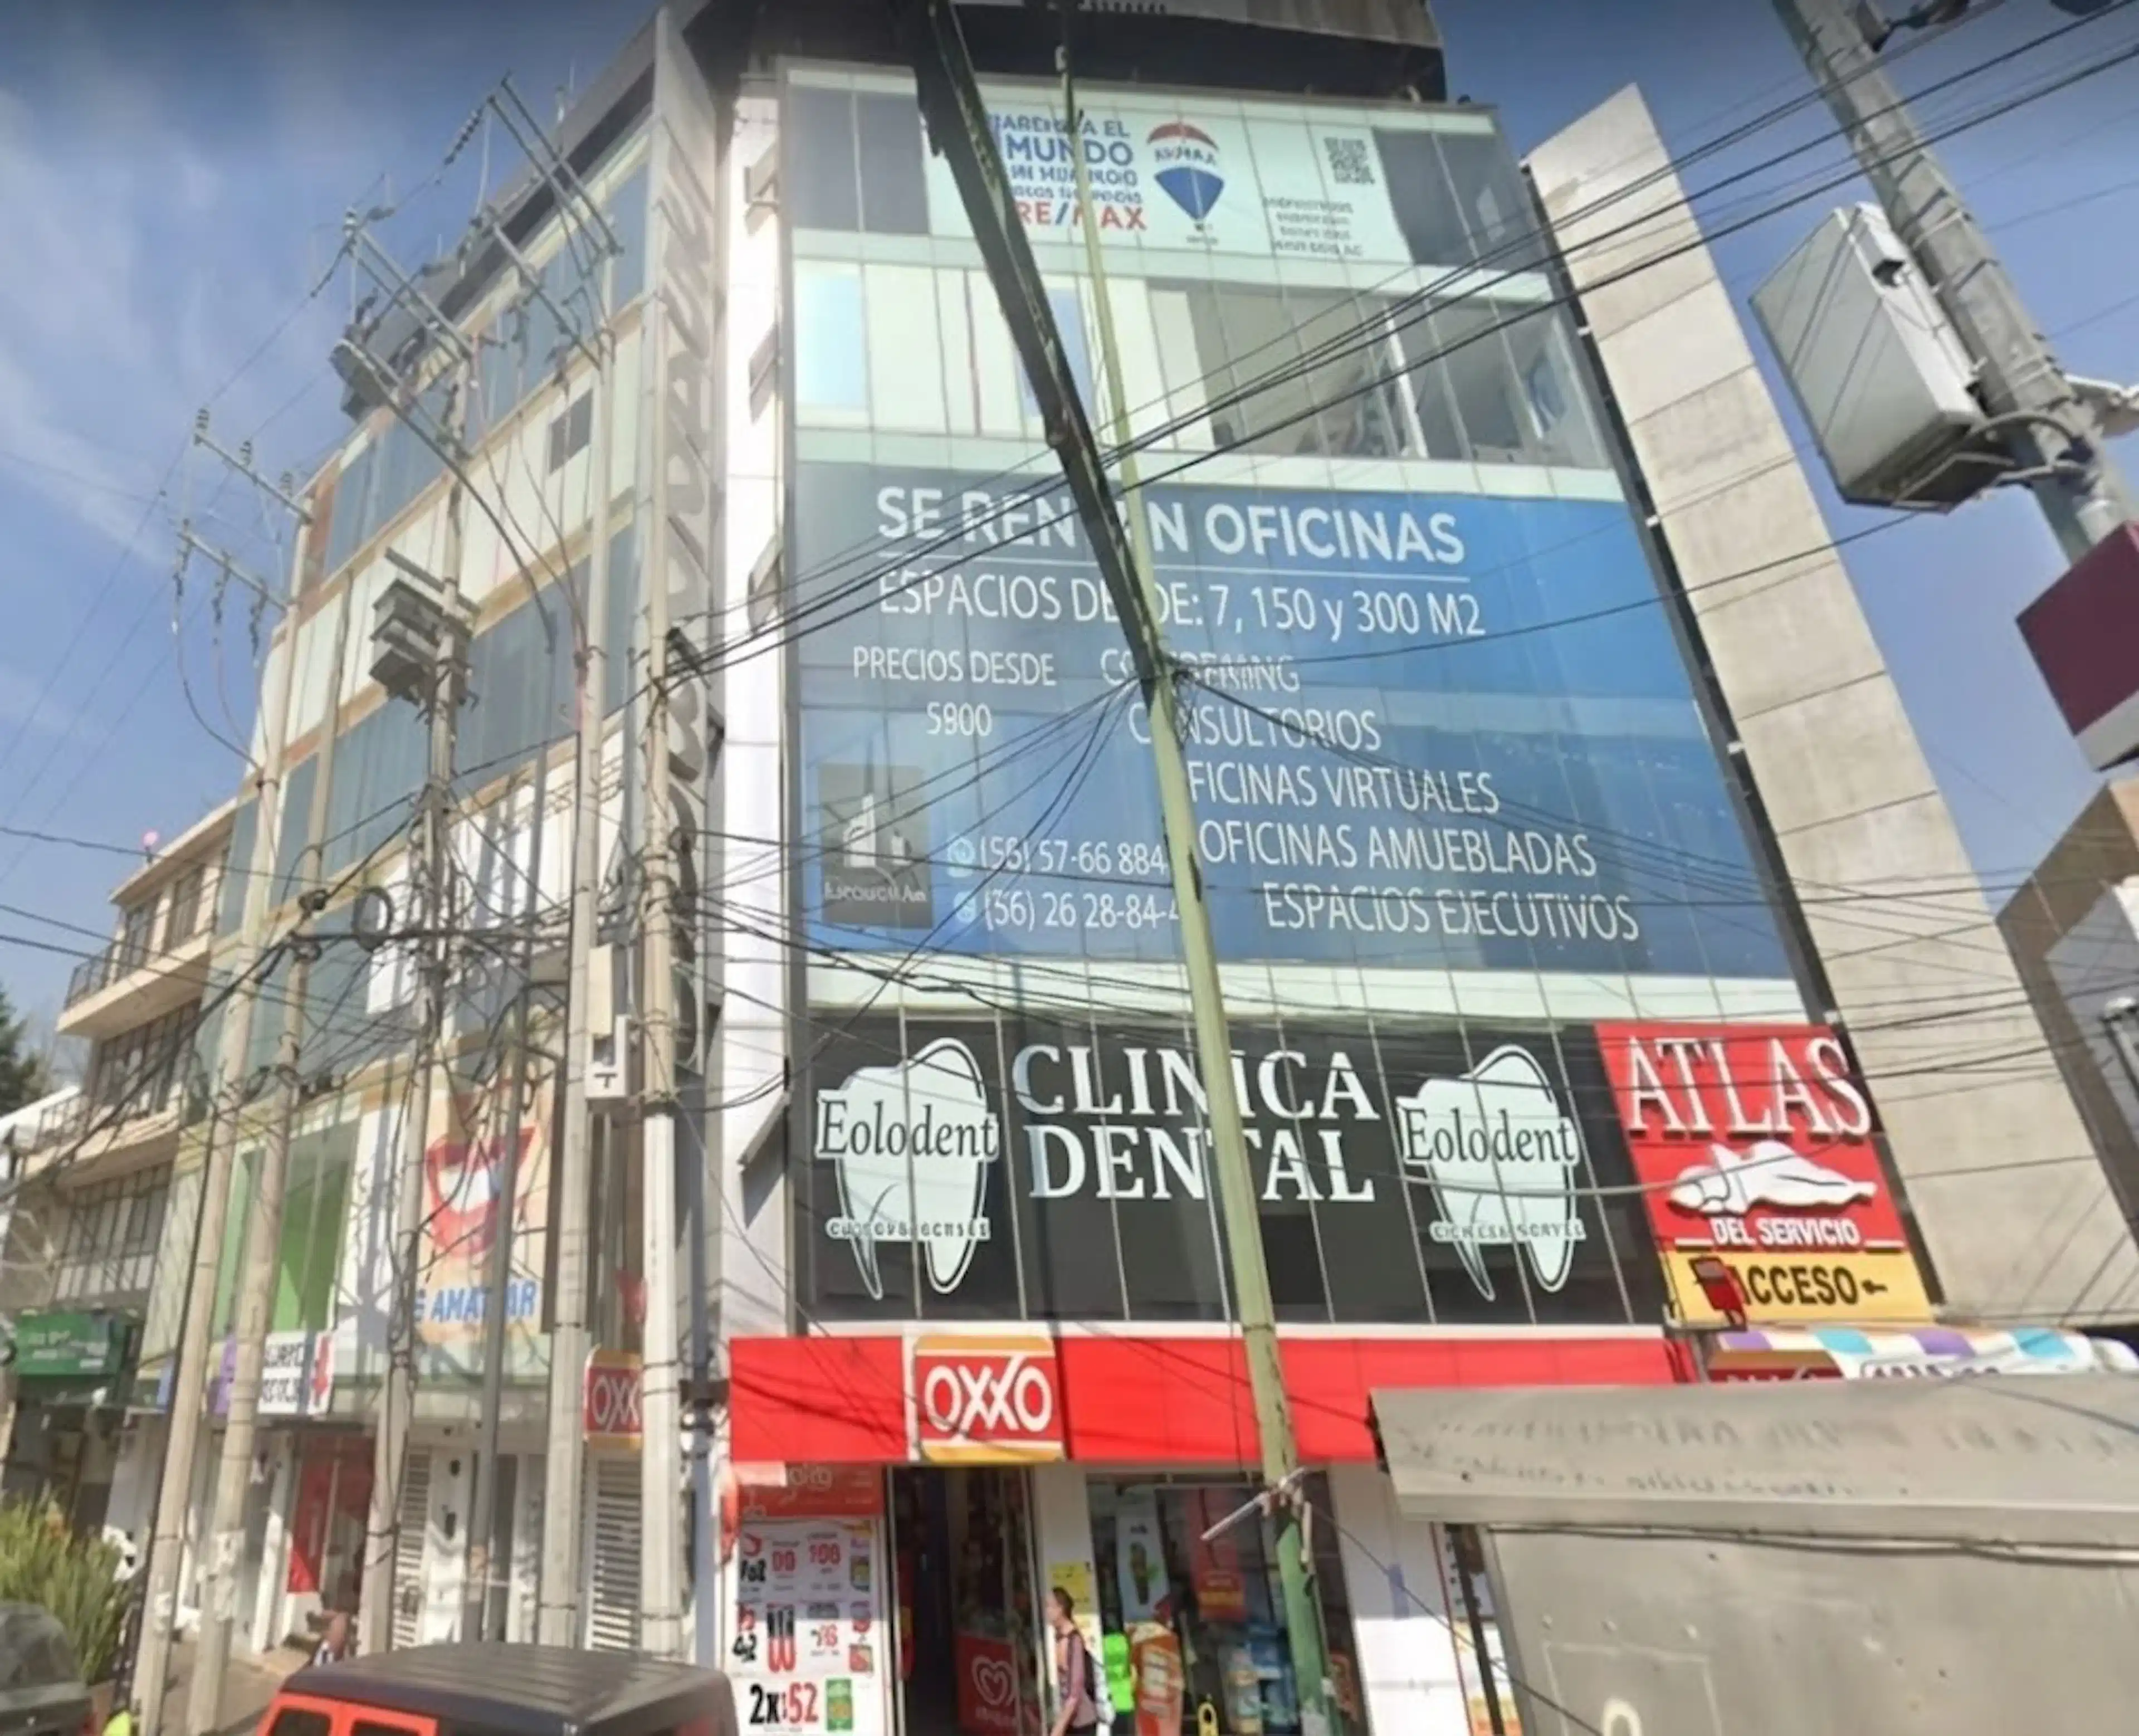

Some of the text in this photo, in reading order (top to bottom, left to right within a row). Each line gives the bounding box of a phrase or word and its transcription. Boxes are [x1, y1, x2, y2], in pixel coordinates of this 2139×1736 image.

[877, 486, 1465, 565] SE RENN OFICINAS
[879, 568, 1061, 621] ESPACIOS
[1071, 578, 1204, 626] DEE:
[1252, 586, 1316, 631] 150
[1323, 599, 1343, 642] y
[1352, 591, 1420, 635] 300
[1427, 592, 1486, 635] M2
[853, 645, 1057, 686] PRECIOS DESDE
[1129, 702, 1382, 751] CNSULTORIOS
[1187, 760, 1500, 816] FICINAS VIRTUALES
[1039, 838, 1112, 875] 57-66
[1199, 819, 1598, 877] OFICINAS AMUEBLADAS
[1042, 891, 1076, 927] 26
[1263, 881, 1639, 942] ESPACIOS EJECUTIVOS
[1012, 1045, 1381, 1120] CLINICA
[1628, 1036, 1871, 1137] ATLAS
[819, 1099, 998, 1157] Eolodent
[1399, 1106, 1576, 1162] Eolodent
[1711, 1217, 1862, 1247] DEL SERVICIO
[592, 1368, 643, 1433] OXX
[924, 1353, 1053, 1440] OXXO
